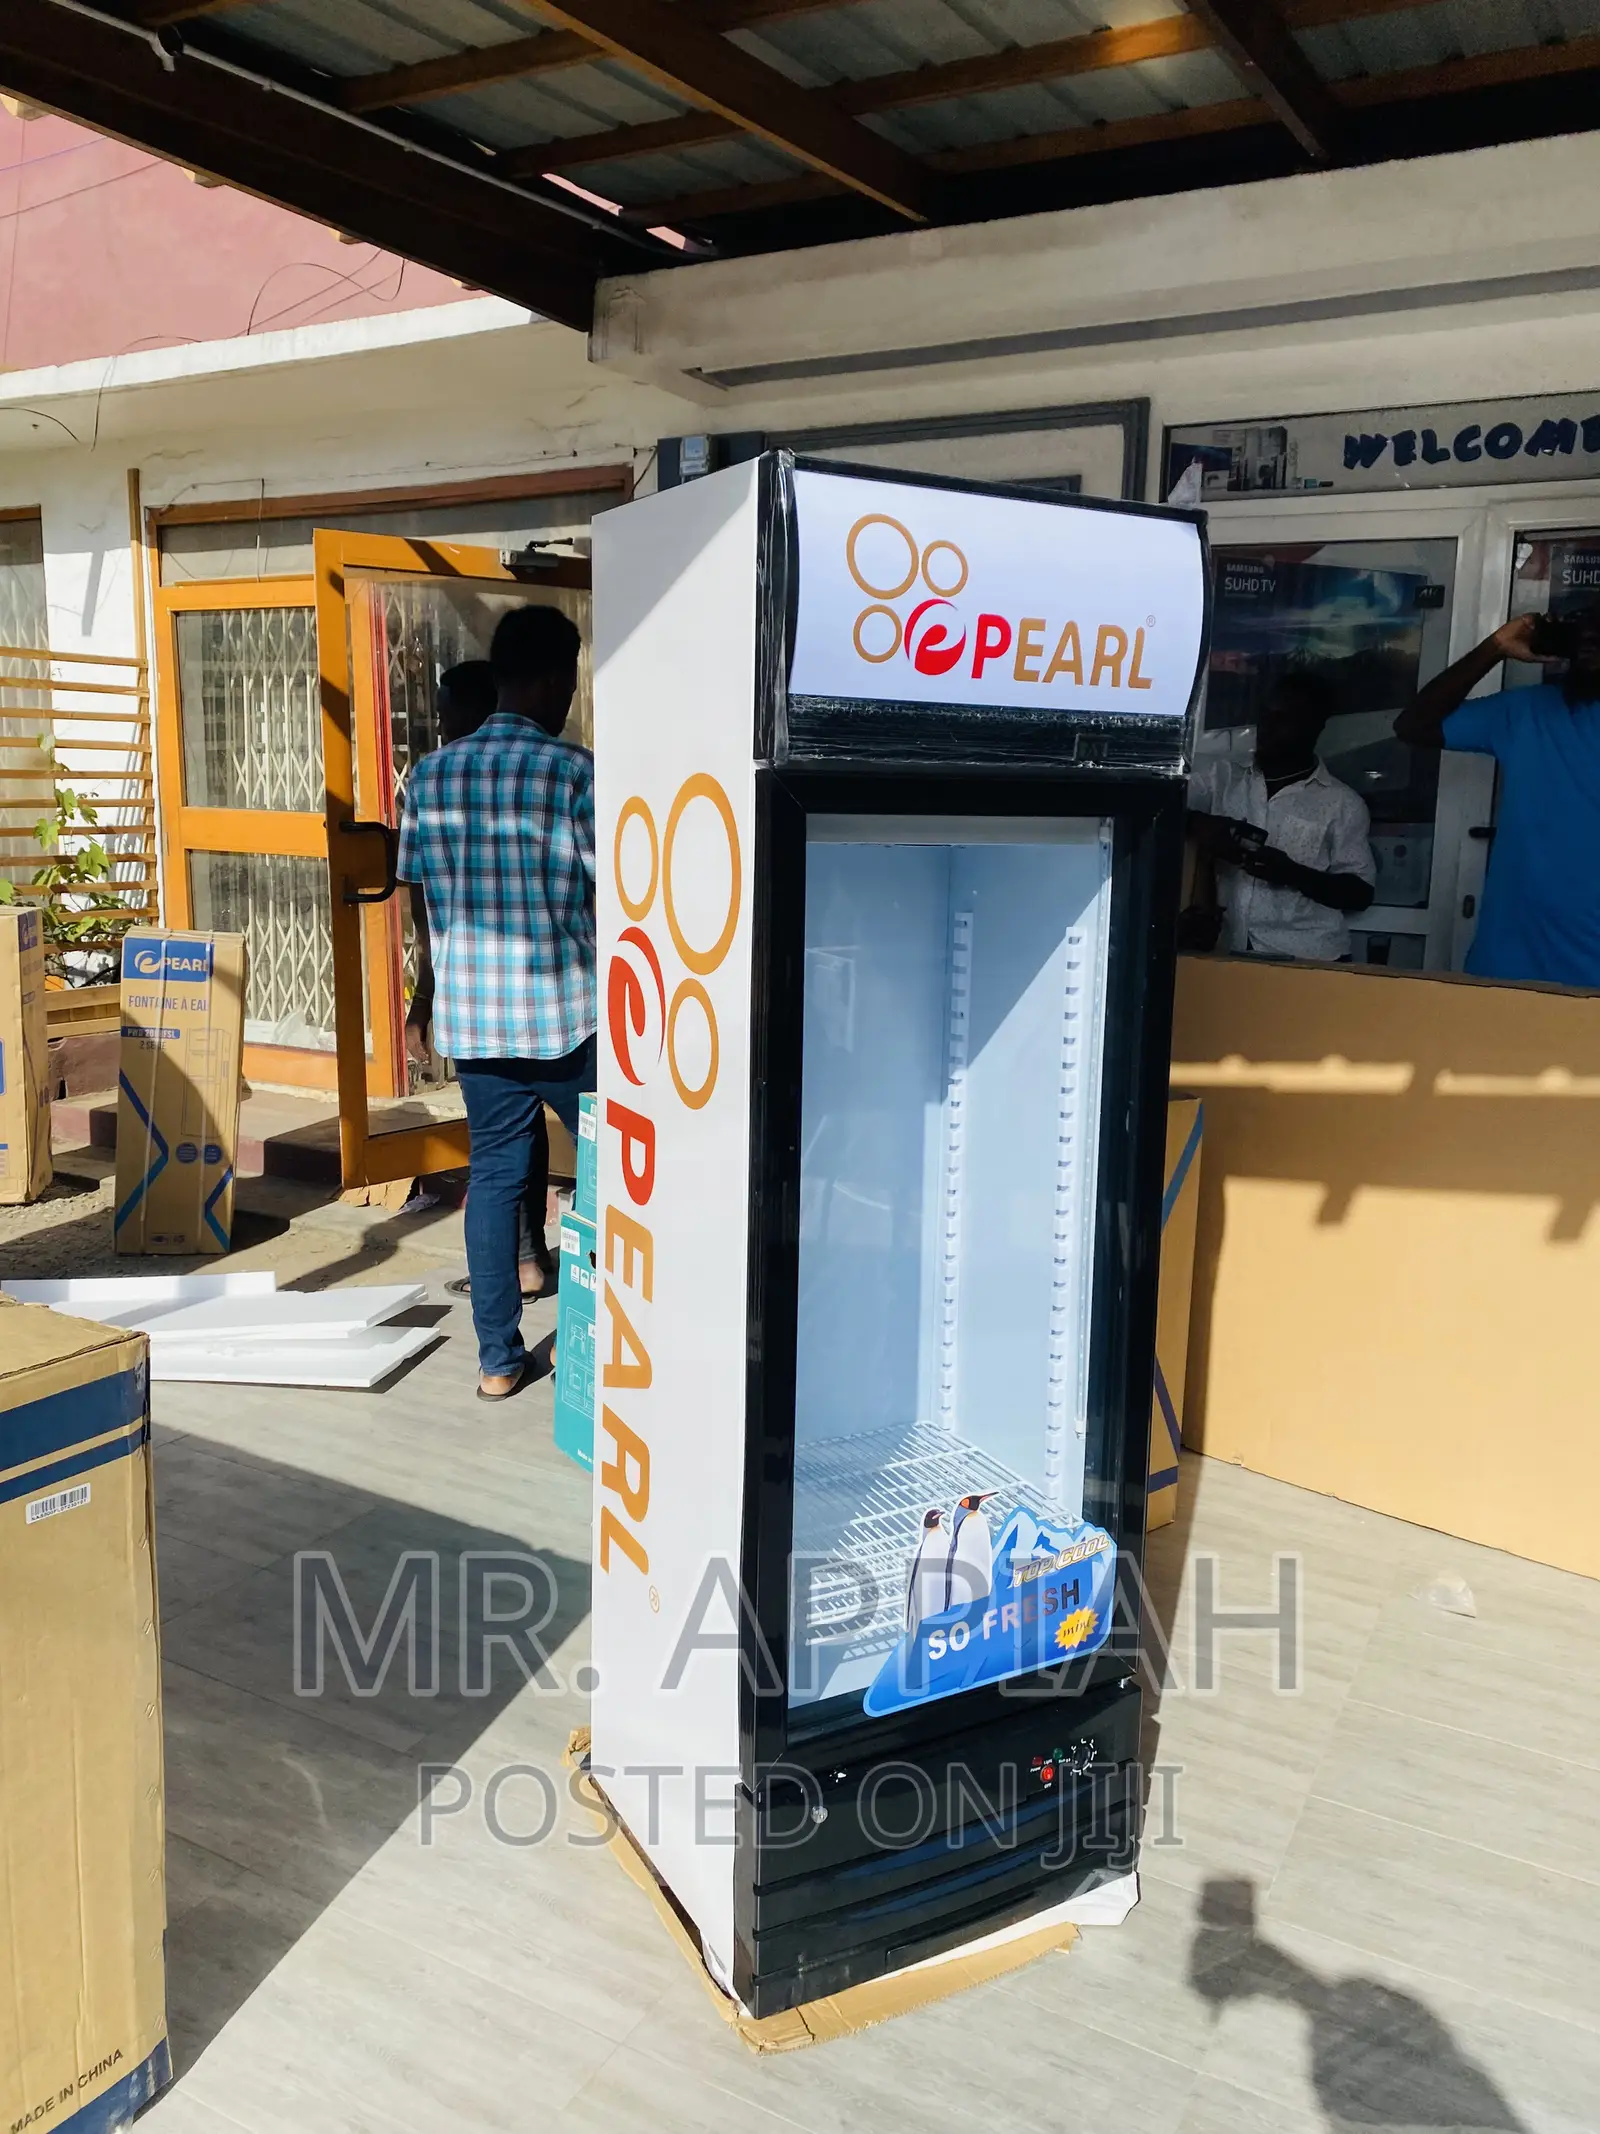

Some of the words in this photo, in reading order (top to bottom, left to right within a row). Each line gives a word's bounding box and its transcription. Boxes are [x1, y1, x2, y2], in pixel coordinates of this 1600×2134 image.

[1343, 415, 1600, 470] WELCOME
[1226, 563, 1265, 574] SAMSUNG
[971, 613, 1154, 690] PEARL
[600, 1098, 656, 1576] PEARL
[1012, 1554, 1057, 1588] TOP
[1056, 1533, 1110, 1571] COOL
[928, 1621, 971, 1661] SO
[982, 1578, 1080, 1641] FRESH
[1062, 1615, 1092, 1639] mini
[10, 2096, 57, 2134] MADE
[59, 2083, 74, 2104] IN
[77, 2048, 124, 2089] CHINA
